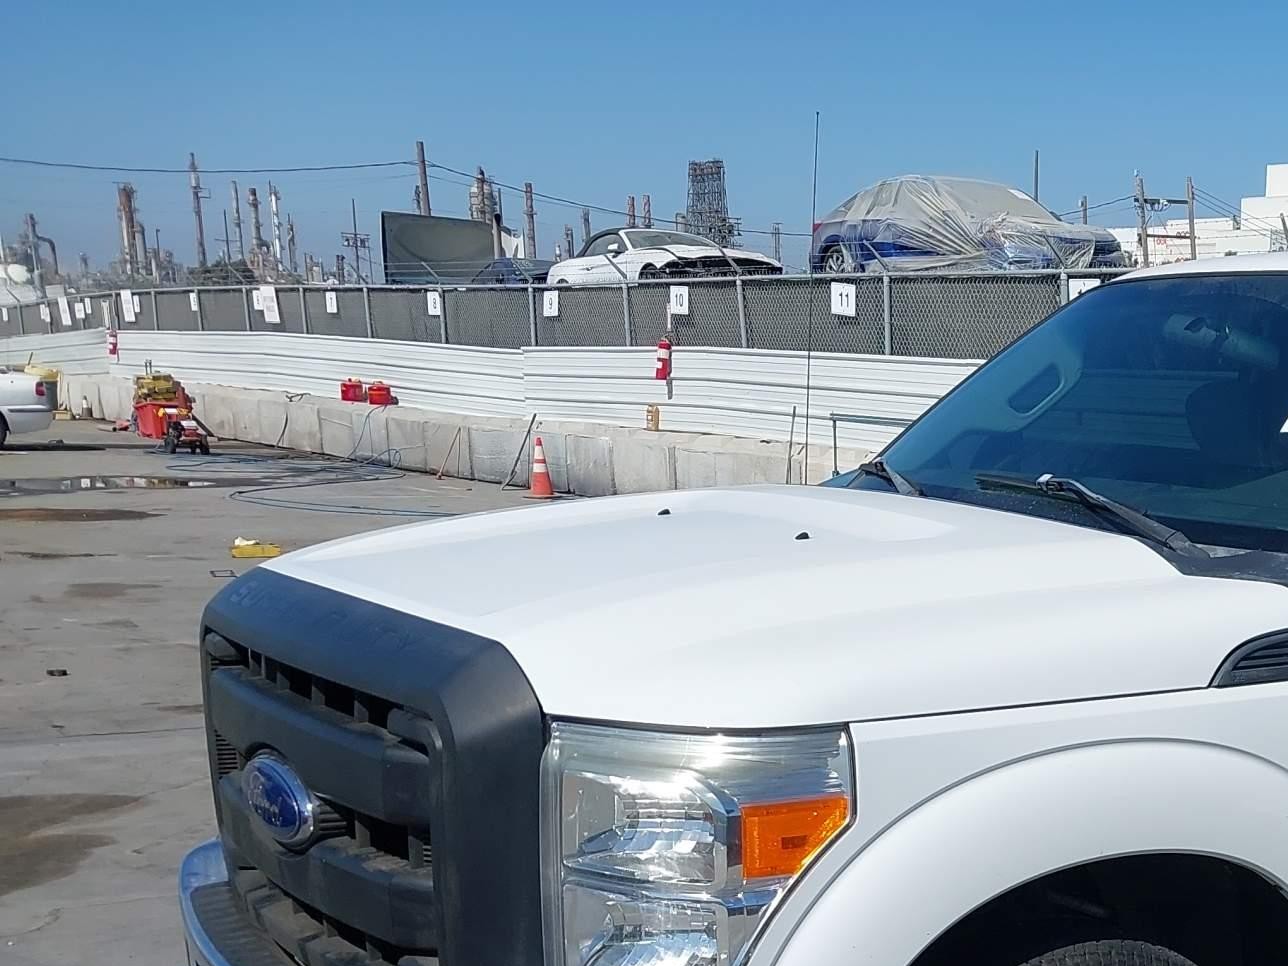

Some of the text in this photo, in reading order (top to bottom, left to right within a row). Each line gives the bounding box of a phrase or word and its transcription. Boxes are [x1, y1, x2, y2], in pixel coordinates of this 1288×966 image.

[548, 297, 553, 309] 9
[675, 293, 684, 307] 10
[839, 292, 849, 307] 11
